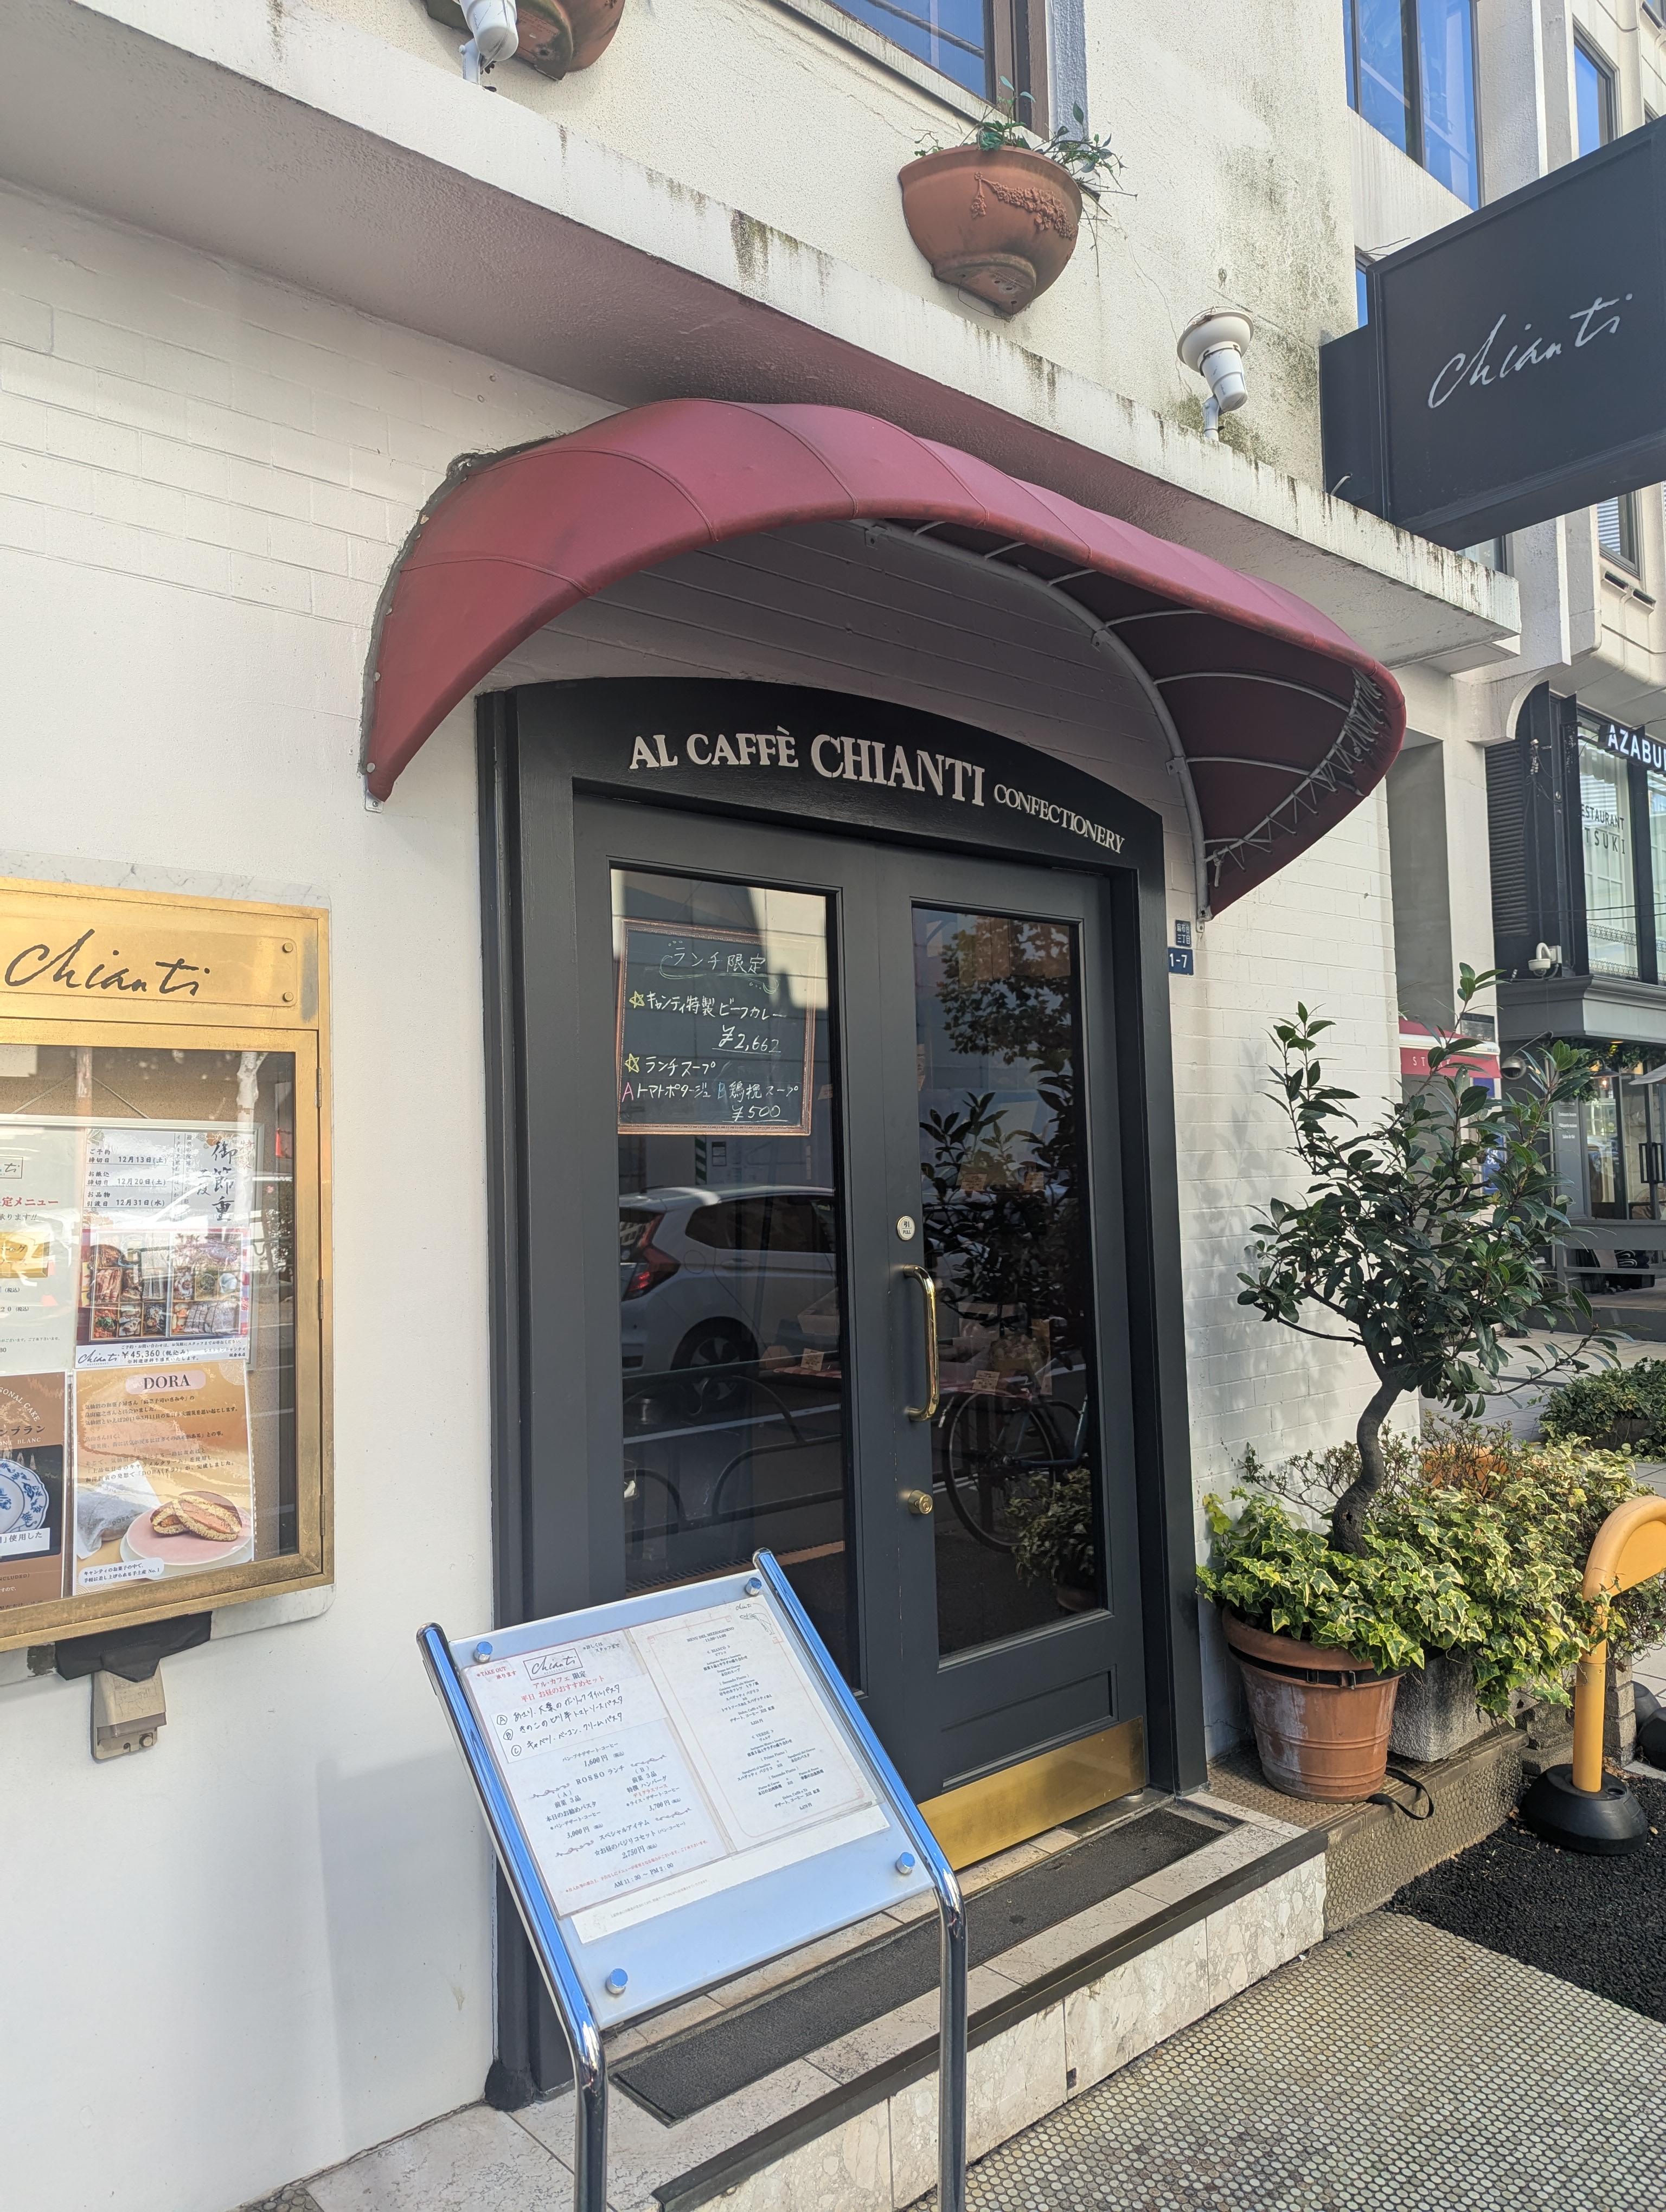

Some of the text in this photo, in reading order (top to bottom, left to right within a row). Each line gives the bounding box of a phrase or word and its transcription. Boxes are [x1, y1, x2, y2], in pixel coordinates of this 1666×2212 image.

[1428, 294, 1632, 408] Chianti
[1608, 724, 1666, 770] AZABU
[629, 725, 1125, 854] AL CAFFÈ CHIANTI CONFECTIONERY
[1581, 803, 1624, 830] ESTAURANT
[1176, 923, 1190, 934] 麻布台
[1177, 934, 1190, 944] 三丁目
[4, 929, 210, 995] Chianti
[672, 947, 766, 974] ランチ限定
[1169, 953, 1188, 968] 1-7
[645, 1056, 716, 1077] ランチスープ
[622, 1082, 634, 1102] A
[637, 1083, 711, 1099] トマトポタージュ
[0, 1197, 59, 1207] 定メニュー
[143, 1374, 191, 1390] DORA
[24, 1403, 40, 1422] CAKE
[531, 1656, 576, 1675] Chianti
[521, 1675, 604, 1702] 平日 お昼のおすすめセット
[533, 1670, 586, 1689] アル・カフェ 限定
[575, 1765, 625, 1785] ROSSO ランチ
[631, 1774, 644, 1784] 前菜
[641, 1775, 667, 1788] ハンバーグ
[546, 1801, 596, 1822] 本日のお勧めパスタ
[554, 1795, 581, 1809] 前菜 3品
[599, 1819, 650, 1841] スペシャルアイテム
[614, 1880, 624, 1888] AM
[649, 1867, 659, 1875] PM
